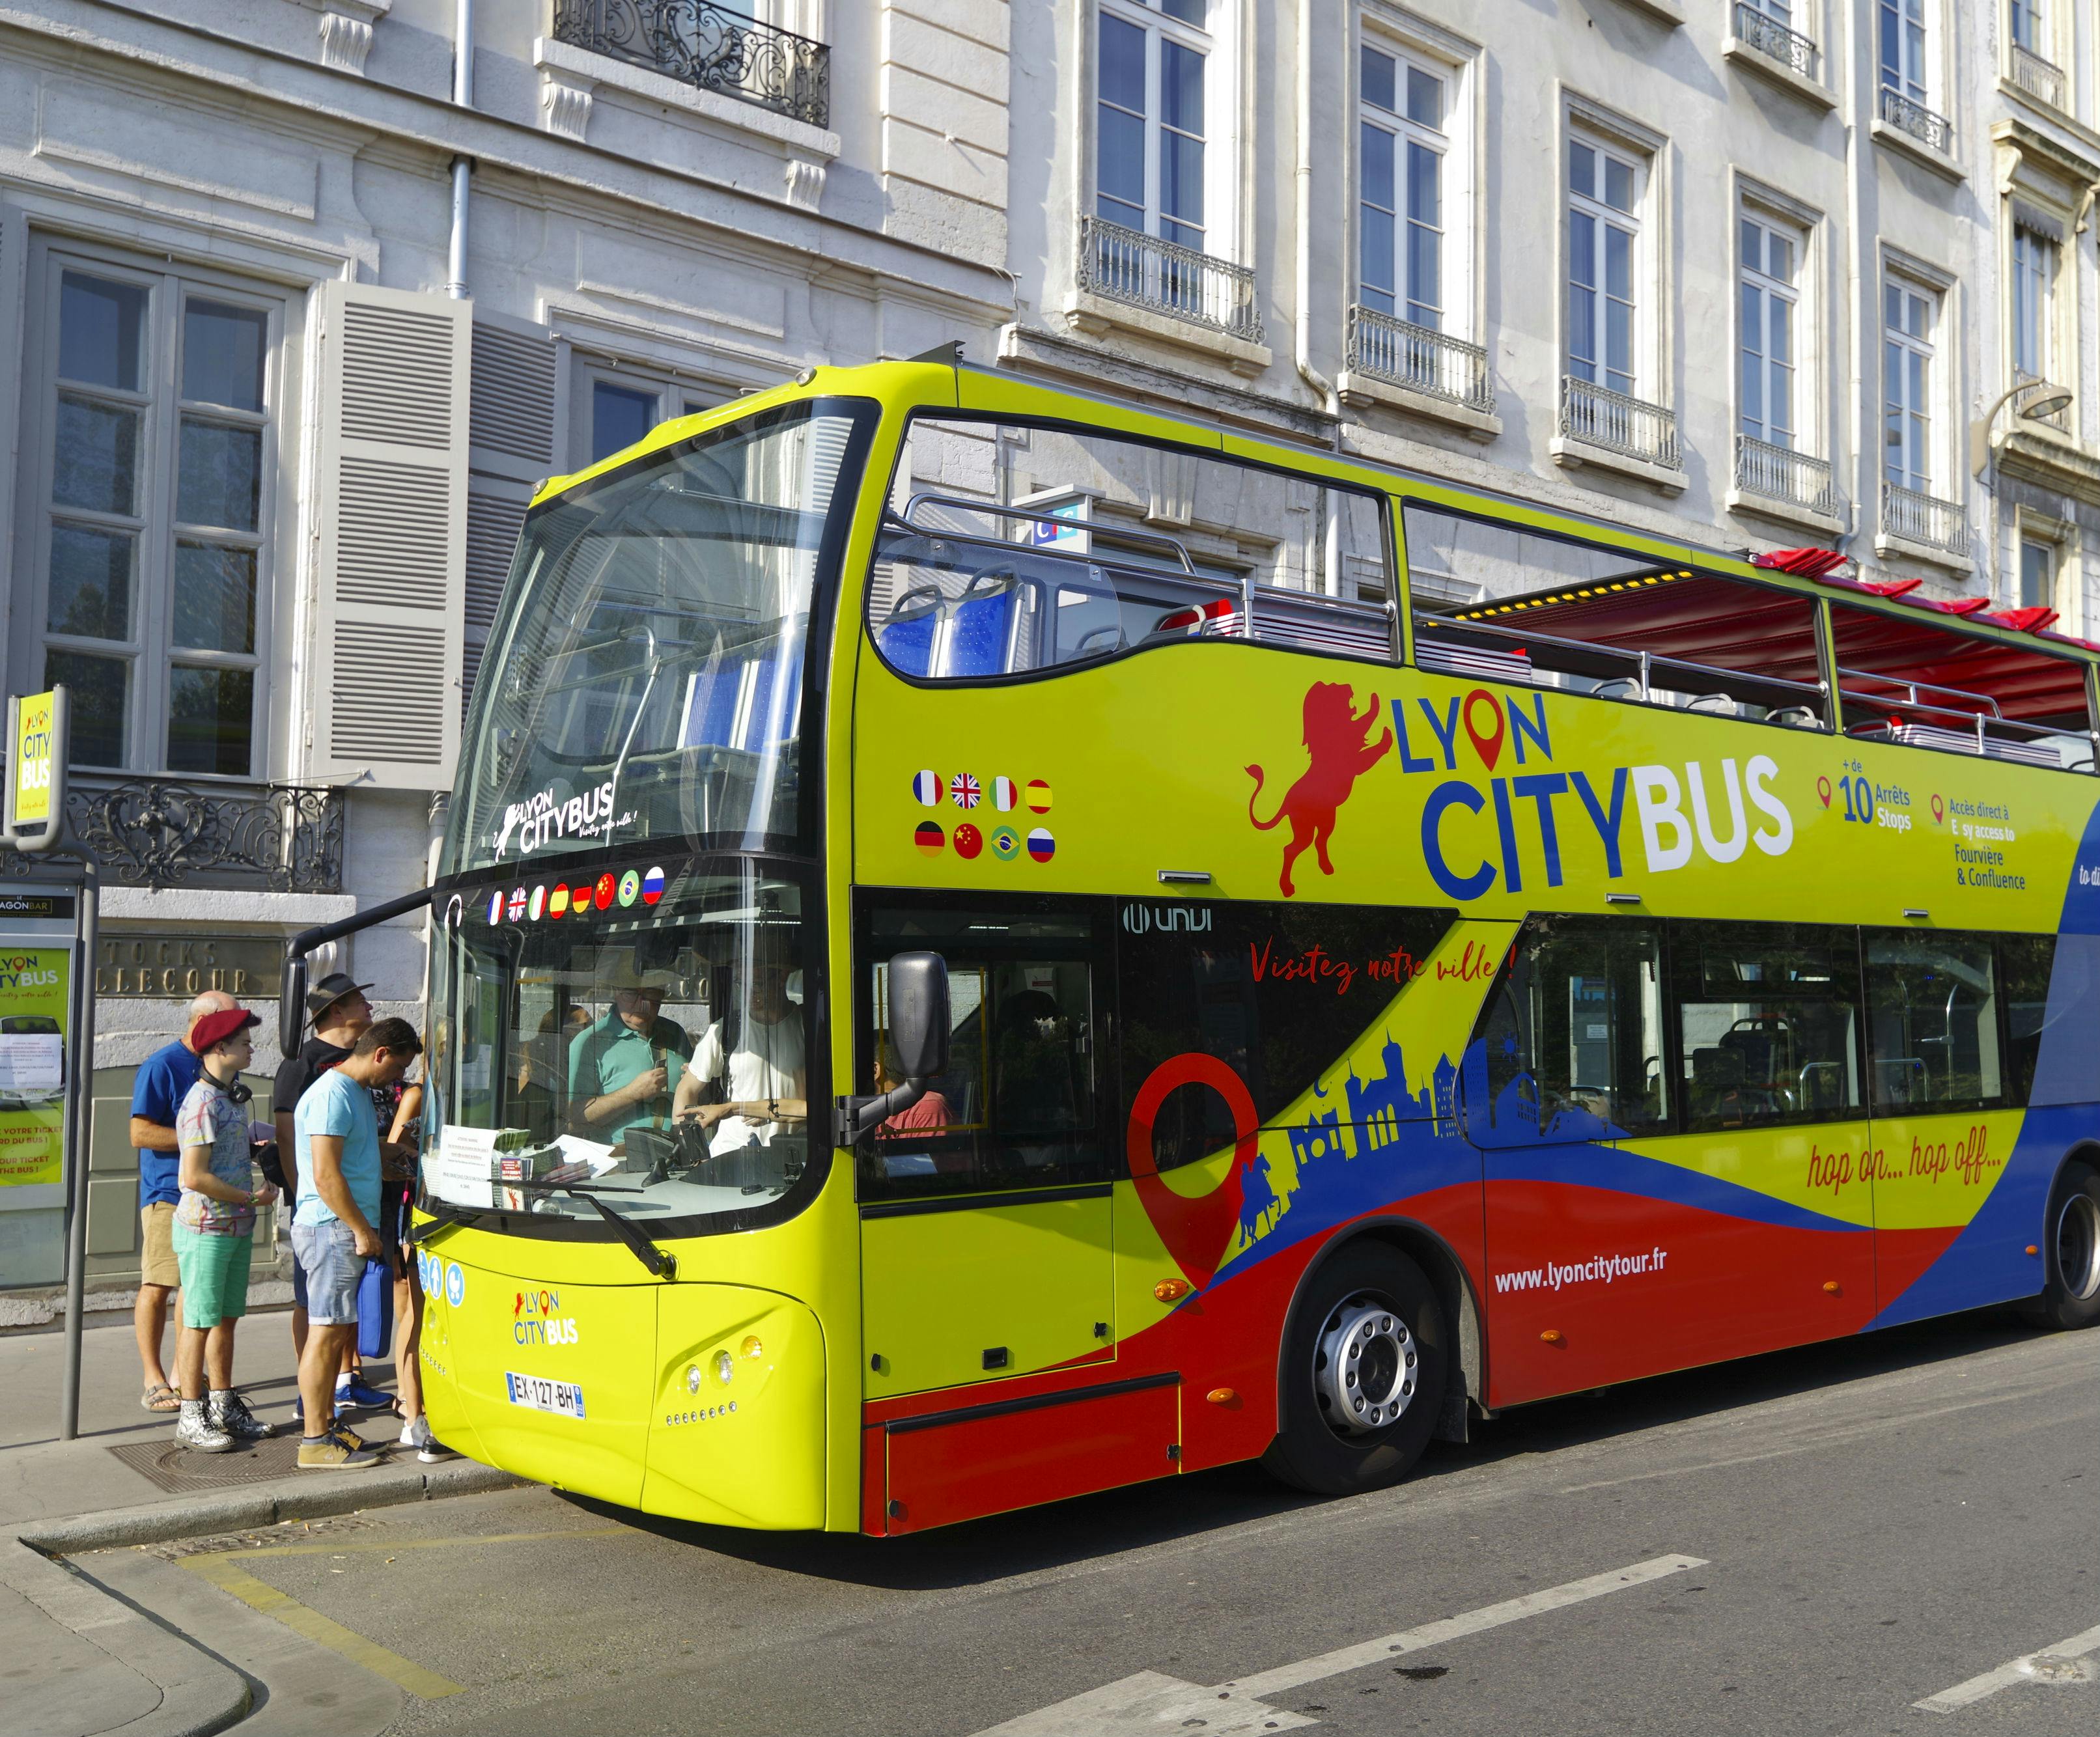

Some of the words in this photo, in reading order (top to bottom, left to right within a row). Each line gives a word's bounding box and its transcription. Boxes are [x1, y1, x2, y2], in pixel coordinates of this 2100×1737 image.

[32, 708, 49, 727] LYON
[1391, 689, 1553, 773] LYON
[24, 731, 51, 759] CITY
[21, 758, 51, 790] BUS
[1851, 758, 1862, 773] de
[519, 788, 553, 824] LYON
[1839, 775, 1873, 824] 10
[1876, 783, 1910, 806] Arrêts
[1950, 798, 1975, 816] Accès
[1977, 801, 2002, 820] direct
[2004, 804, 2009, 820] à
[520, 782, 613, 854] CITYBUS
[579, 820, 600, 838] Visitez
[1421, 755, 1794, 901] CITYBUS
[1877, 807, 1912, 834] Stops
[1975, 825, 2004, 841] access
[2005, 827, 2015, 842] to
[1955, 844, 2004, 866] Fourvière
[1957, 868, 1967, 885] &
[1968, 868, 2026, 890] Confluence
[2079, 865, 2090, 885] to
[1250, 934, 1359, 995] Visitez
[1367, 945, 1427, 984] notre
[1437, 940, 1498, 982] ville
[1807, 1145, 1854, 1196] hop
[1909, 1135, 1950, 1184] hop
[1955, 1125, 2001, 1186] off...
[1495, 1247, 1667, 1293] www.lyoncitytour.fr
[525, 1290, 559, 1318] LYON
[514, 1318, 579, 1346] CITYBUS
[514, 1376, 574, 1410] EX-127-BH
